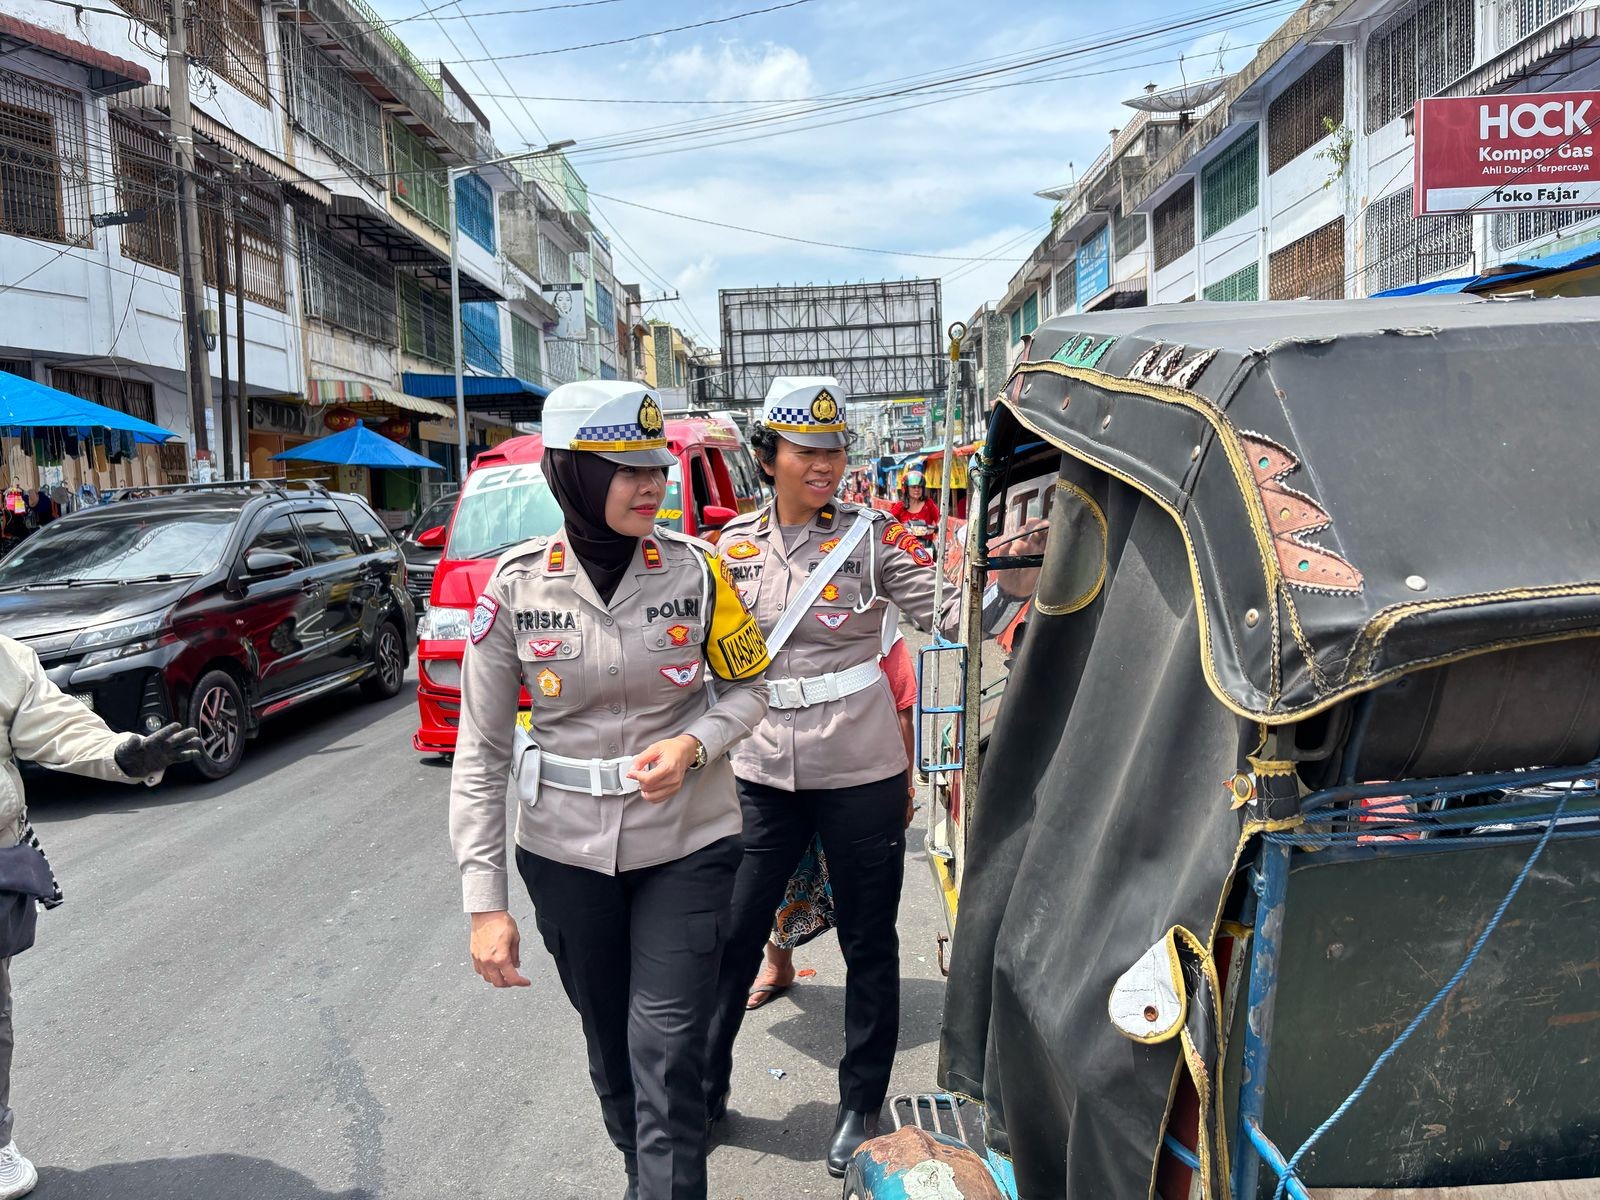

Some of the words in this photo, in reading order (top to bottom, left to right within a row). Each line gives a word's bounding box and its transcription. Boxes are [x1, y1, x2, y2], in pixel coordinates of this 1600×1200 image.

[1479, 99, 1593, 140] HOCK
[1479, 146, 1554, 163] Kompor
[1558, 143, 1593, 159] Gas
[1482, 165, 1502, 175] Ahli
[1536, 163, 1590, 174] Terpercaya
[1494, 189, 1533, 203] Toko
[1537, 187, 1580, 203] Fajar
[808, 560, 861, 575] PRI
[516, 609, 576, 631] FRISKA
[646, 598, 699, 623] POLRI
